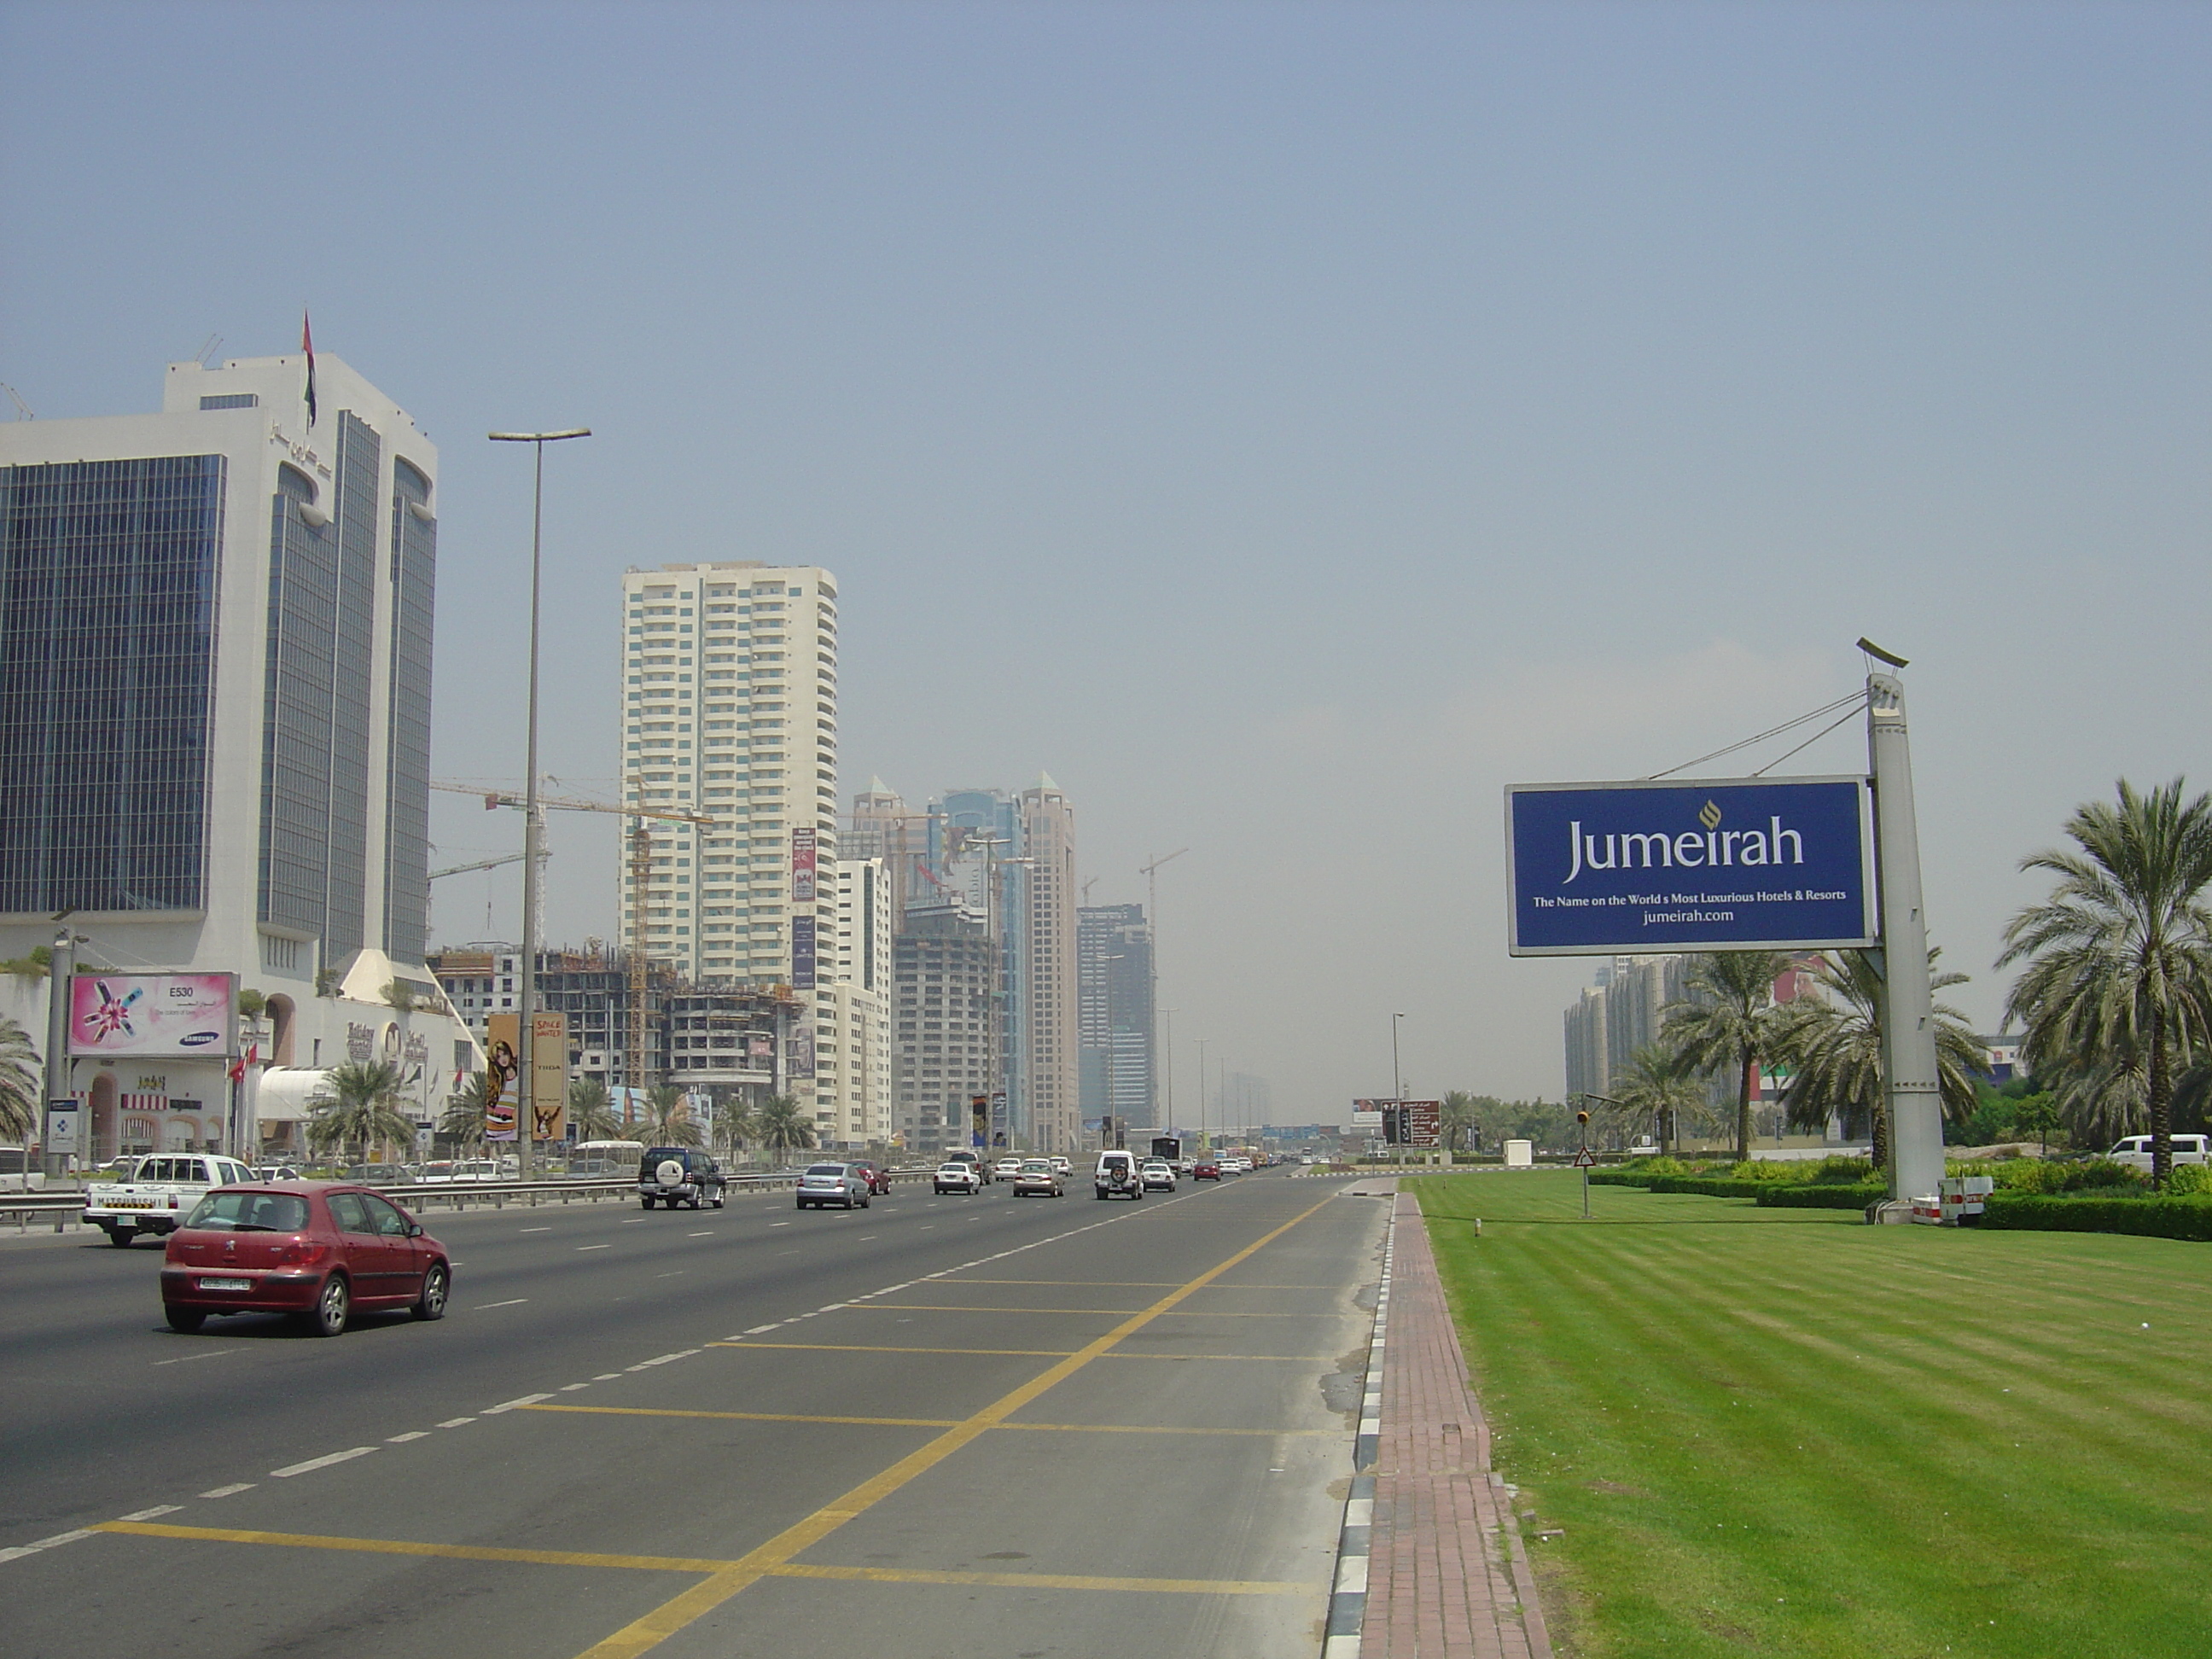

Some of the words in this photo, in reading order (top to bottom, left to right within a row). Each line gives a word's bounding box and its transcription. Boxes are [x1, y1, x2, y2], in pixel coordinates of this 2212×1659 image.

[1563, 816, 1804, 884] Jumeirah
[1533, 897, 1555, 907] The
[1557, 896, 1590, 907] Name
[1592, 898, 1606, 906] on
[1608, 895, 1627, 905] the
[1671, 893, 1698, 904] Most
[1701, 892, 1755, 903] Luxurious
[1756, 890, 1793, 902] Hotels
[1795, 890, 1804, 900] &
[1806, 889, 1847, 900] Resorts
[1642, 910, 1734, 926] jumeirah.com
[169, 987, 194, 998] E530
[537, 1020, 561, 1029] SPACE
[183, 1034, 215, 1043] SAMSUNG
